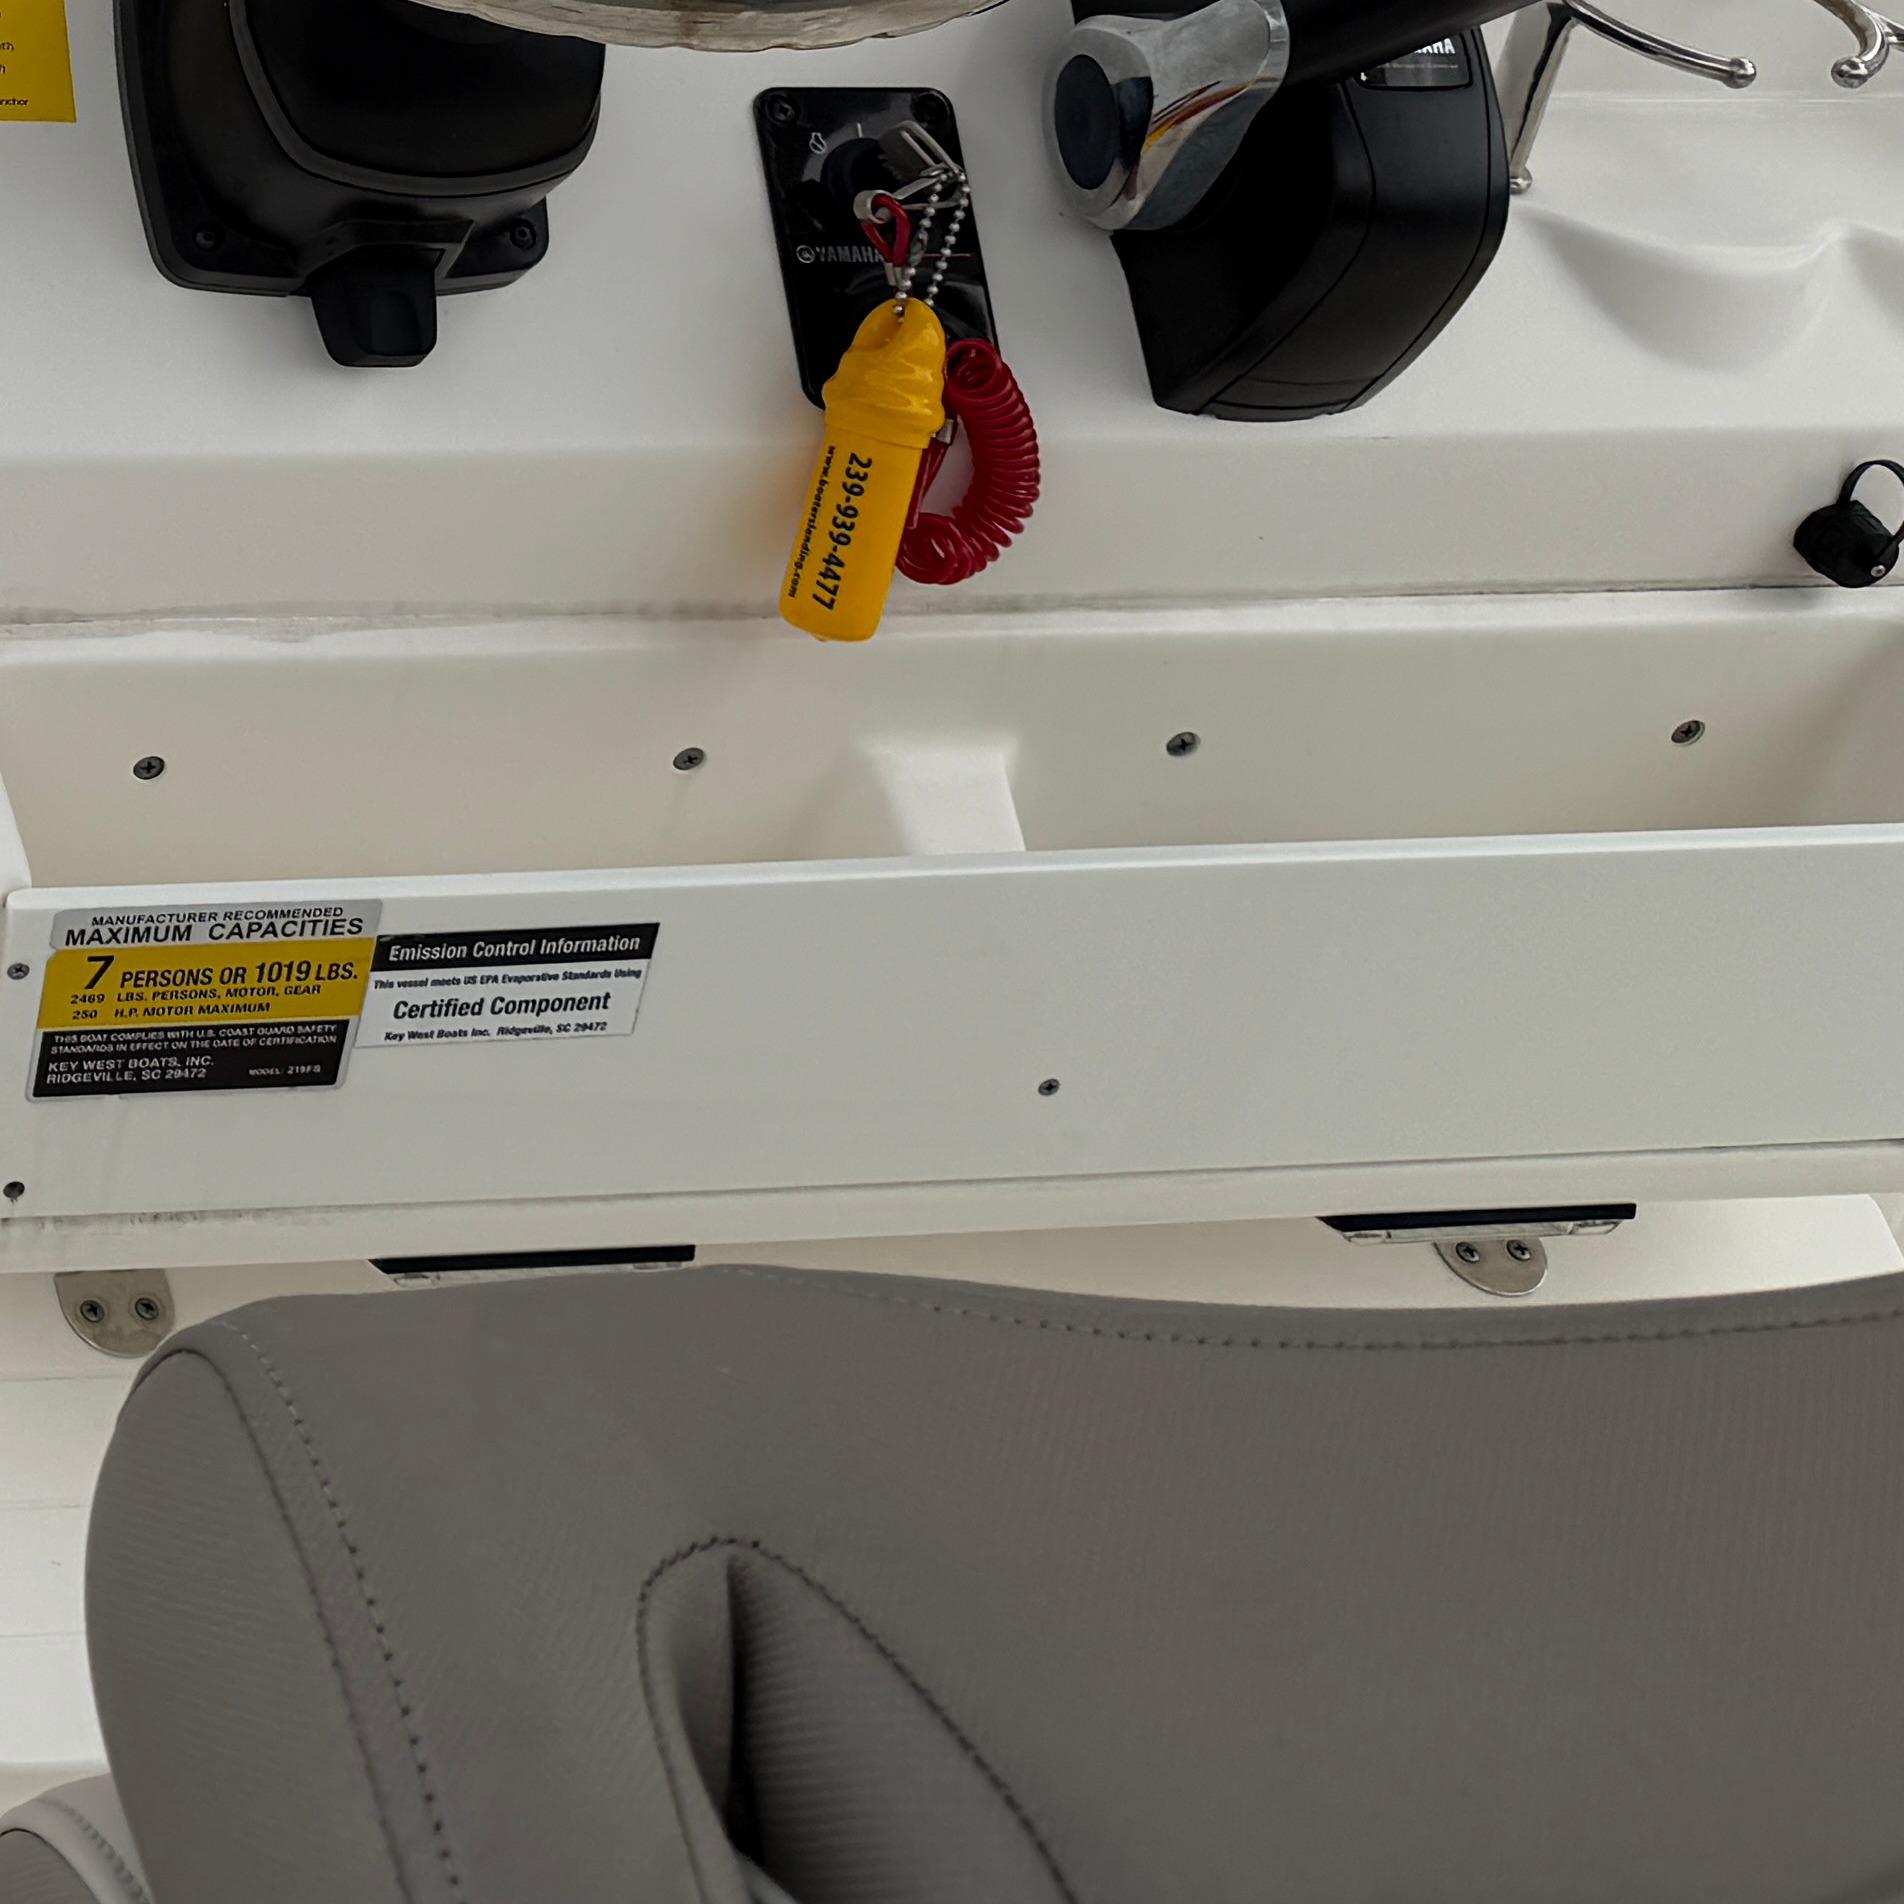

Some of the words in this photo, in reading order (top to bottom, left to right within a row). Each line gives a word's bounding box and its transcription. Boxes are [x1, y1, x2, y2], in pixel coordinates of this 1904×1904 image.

[815, 245, 885, 263] YAMAHA
[788, 445, 836, 598] www.boaterslanding.com
[812, 452, 873, 610] 239-939-4477
[92, 912, 217, 926] MANUFACTURER
[223, 907, 343, 921] RECOMMENDED
[65, 924, 192, 946] MAXIMUM
[209, 918, 364, 940] CAPACITIES
[389, 943, 468, 962] Emission
[472, 939, 536, 958] Control
[540, 934, 641, 955] Information
[84, 955, 114, 989] 7
[120, 968, 213, 988] PERSONS
[219, 966, 247, 985] OR
[255, 960, 312, 983] 1019
[315, 962, 358, 981] LBS.
[374, 979, 394, 990] This
[397, 977, 429, 988] vessel
[430, 977, 461, 987] meets
[463, 975, 478, 985] US
[479, 974, 499, 985] EPA
[501, 972, 560, 984] Evaporative
[561, 969, 612, 981] Standards
[614, 967, 642, 980] Using
[117, 991, 147, 1002] LBS.
[284, 984, 321, 996] GEAR
[72, 1009, 97, 1020] 250
[114, 1008, 139, 1018] H.P.
[143, 1006, 194, 1016] MOTOR
[198, 1002, 270, 1015] MAXIMUM
[393, 997, 485, 1020] Certified
[490, 991, 612, 1017] Component
[55, 1035, 77, 1043] THIS
[80, 1033, 108, 1043] BOAT
[110, 1031, 165, 1041] COMPLIES
[167, 1030, 194, 1039] WITH
[218, 1027, 255, 1037] COAST
[257, 1025, 295, 1036] GUARD
[297, 1024, 338, 1034] SAFETY
[384, 1031, 405, 1042] Key
[407, 1029, 435, 1040] West
[436, 1028, 468, 1039] Boats
[556, 1022, 571, 1033] SC
[573, 1021, 608, 1033] 29472
[51, 1044, 114, 1054] STANDARDS
[116, 1043, 128, 1052] IN
[130, 1041, 169, 1051] EFFECT
[171, 1041, 188, 1050] ON
[190, 1039, 211, 1049] THE
[212, 1038, 240, 1048] DATE
[242, 1037, 258, 1047] OF
[259, 1035, 338, 1046] CERTIFICATION
[48, 1061, 79, 1072] KEY
[82, 1059, 125, 1071] WEST
[185, 1055, 214, 1067] INC.
[141, 1069, 162, 1080] SC
